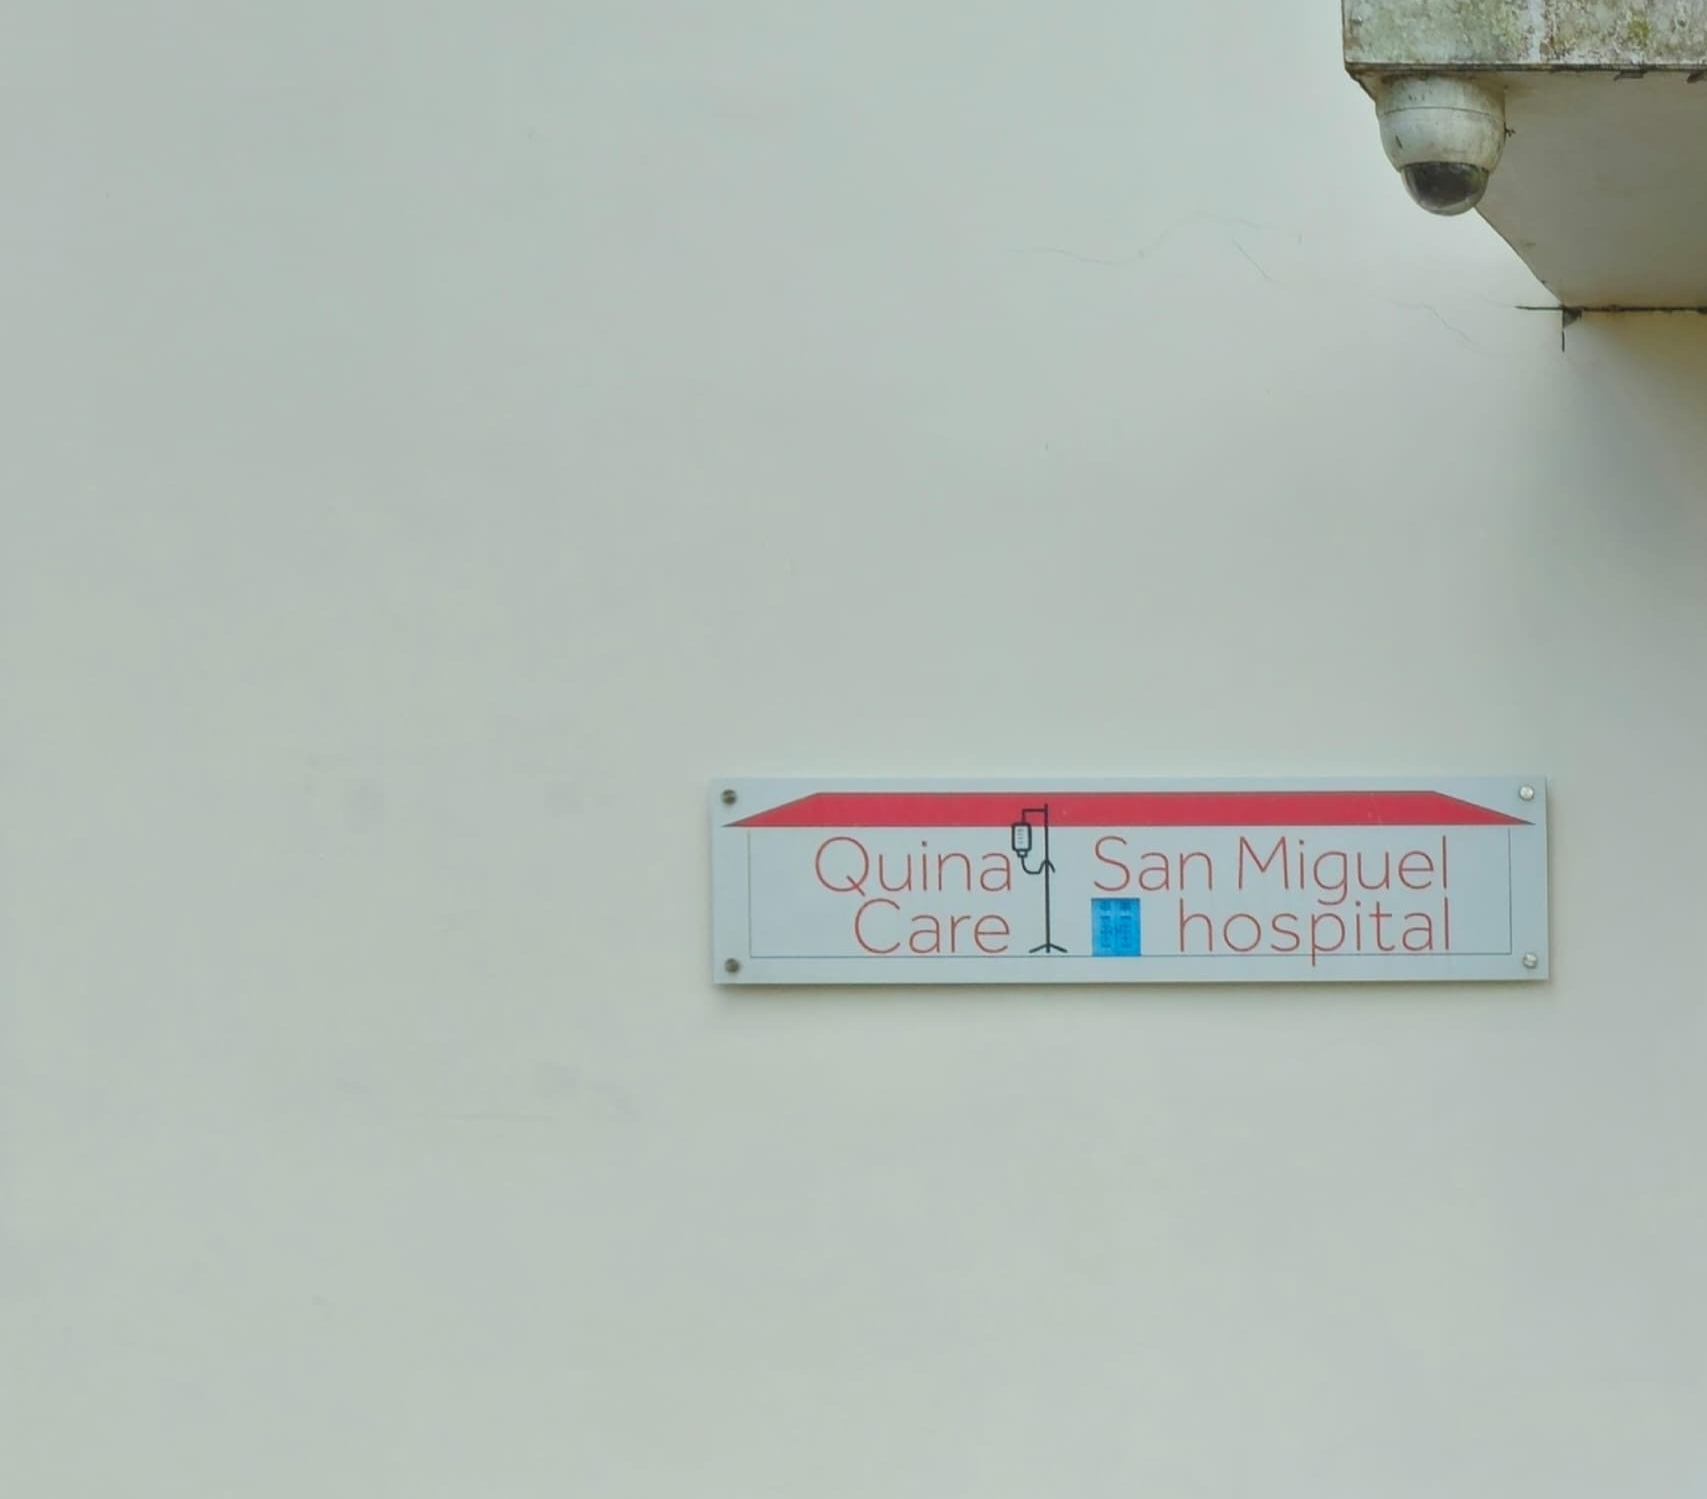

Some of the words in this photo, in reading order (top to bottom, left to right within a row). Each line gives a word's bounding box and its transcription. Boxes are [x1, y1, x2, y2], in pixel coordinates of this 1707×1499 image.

[814, 834, 1013, 899] Quina
[1092, 836, 1215, 892] San
[1237, 834, 1449, 906] Miguel
[853, 897, 1012, 955] Care
[1178, 898, 1451, 966] hospital
